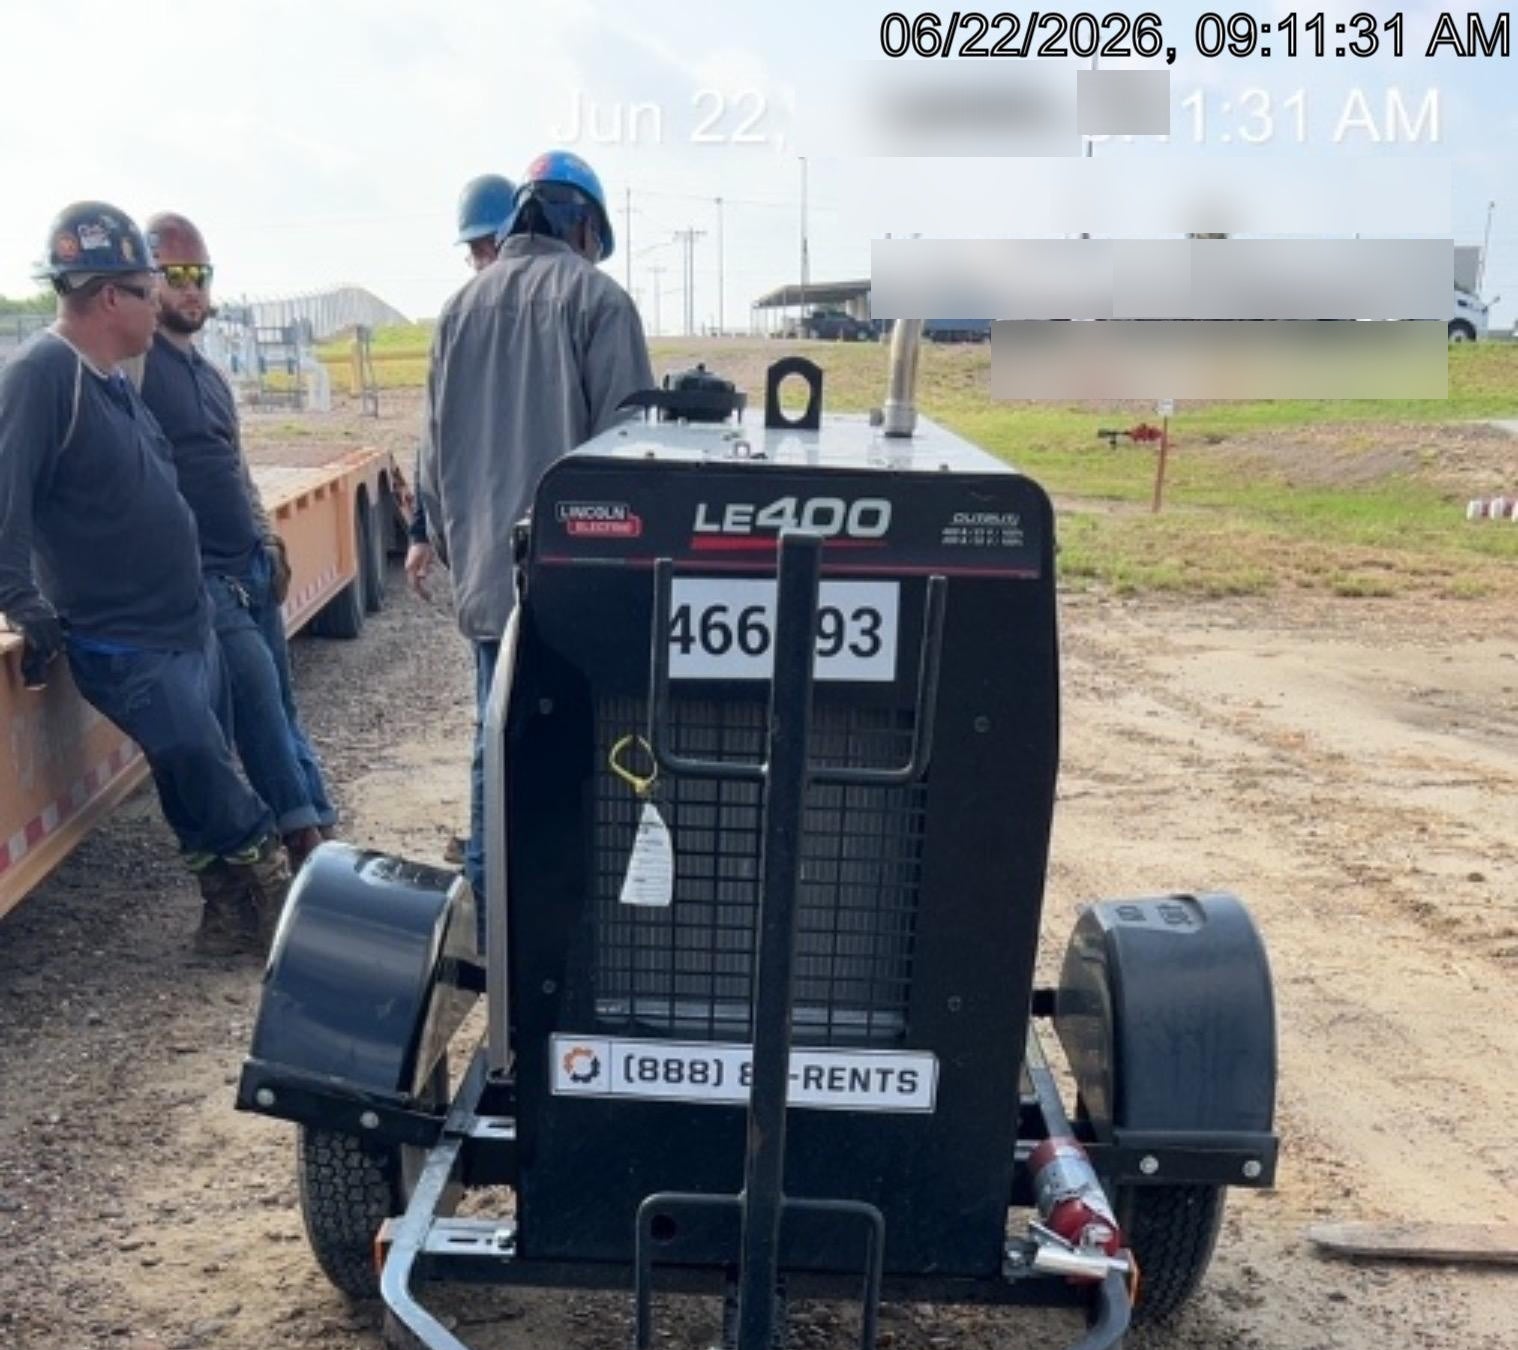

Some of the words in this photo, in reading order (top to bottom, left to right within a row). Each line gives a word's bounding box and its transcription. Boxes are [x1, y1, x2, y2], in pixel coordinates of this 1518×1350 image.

[560, 505, 626, 521] LINCOLN
[693, 497, 892, 538] LE400
[668, 604, 883, 658] 46693
[623, 1054, 724, 1087] (888)
[739, 1061, 919, 1095] 8-RENTS
